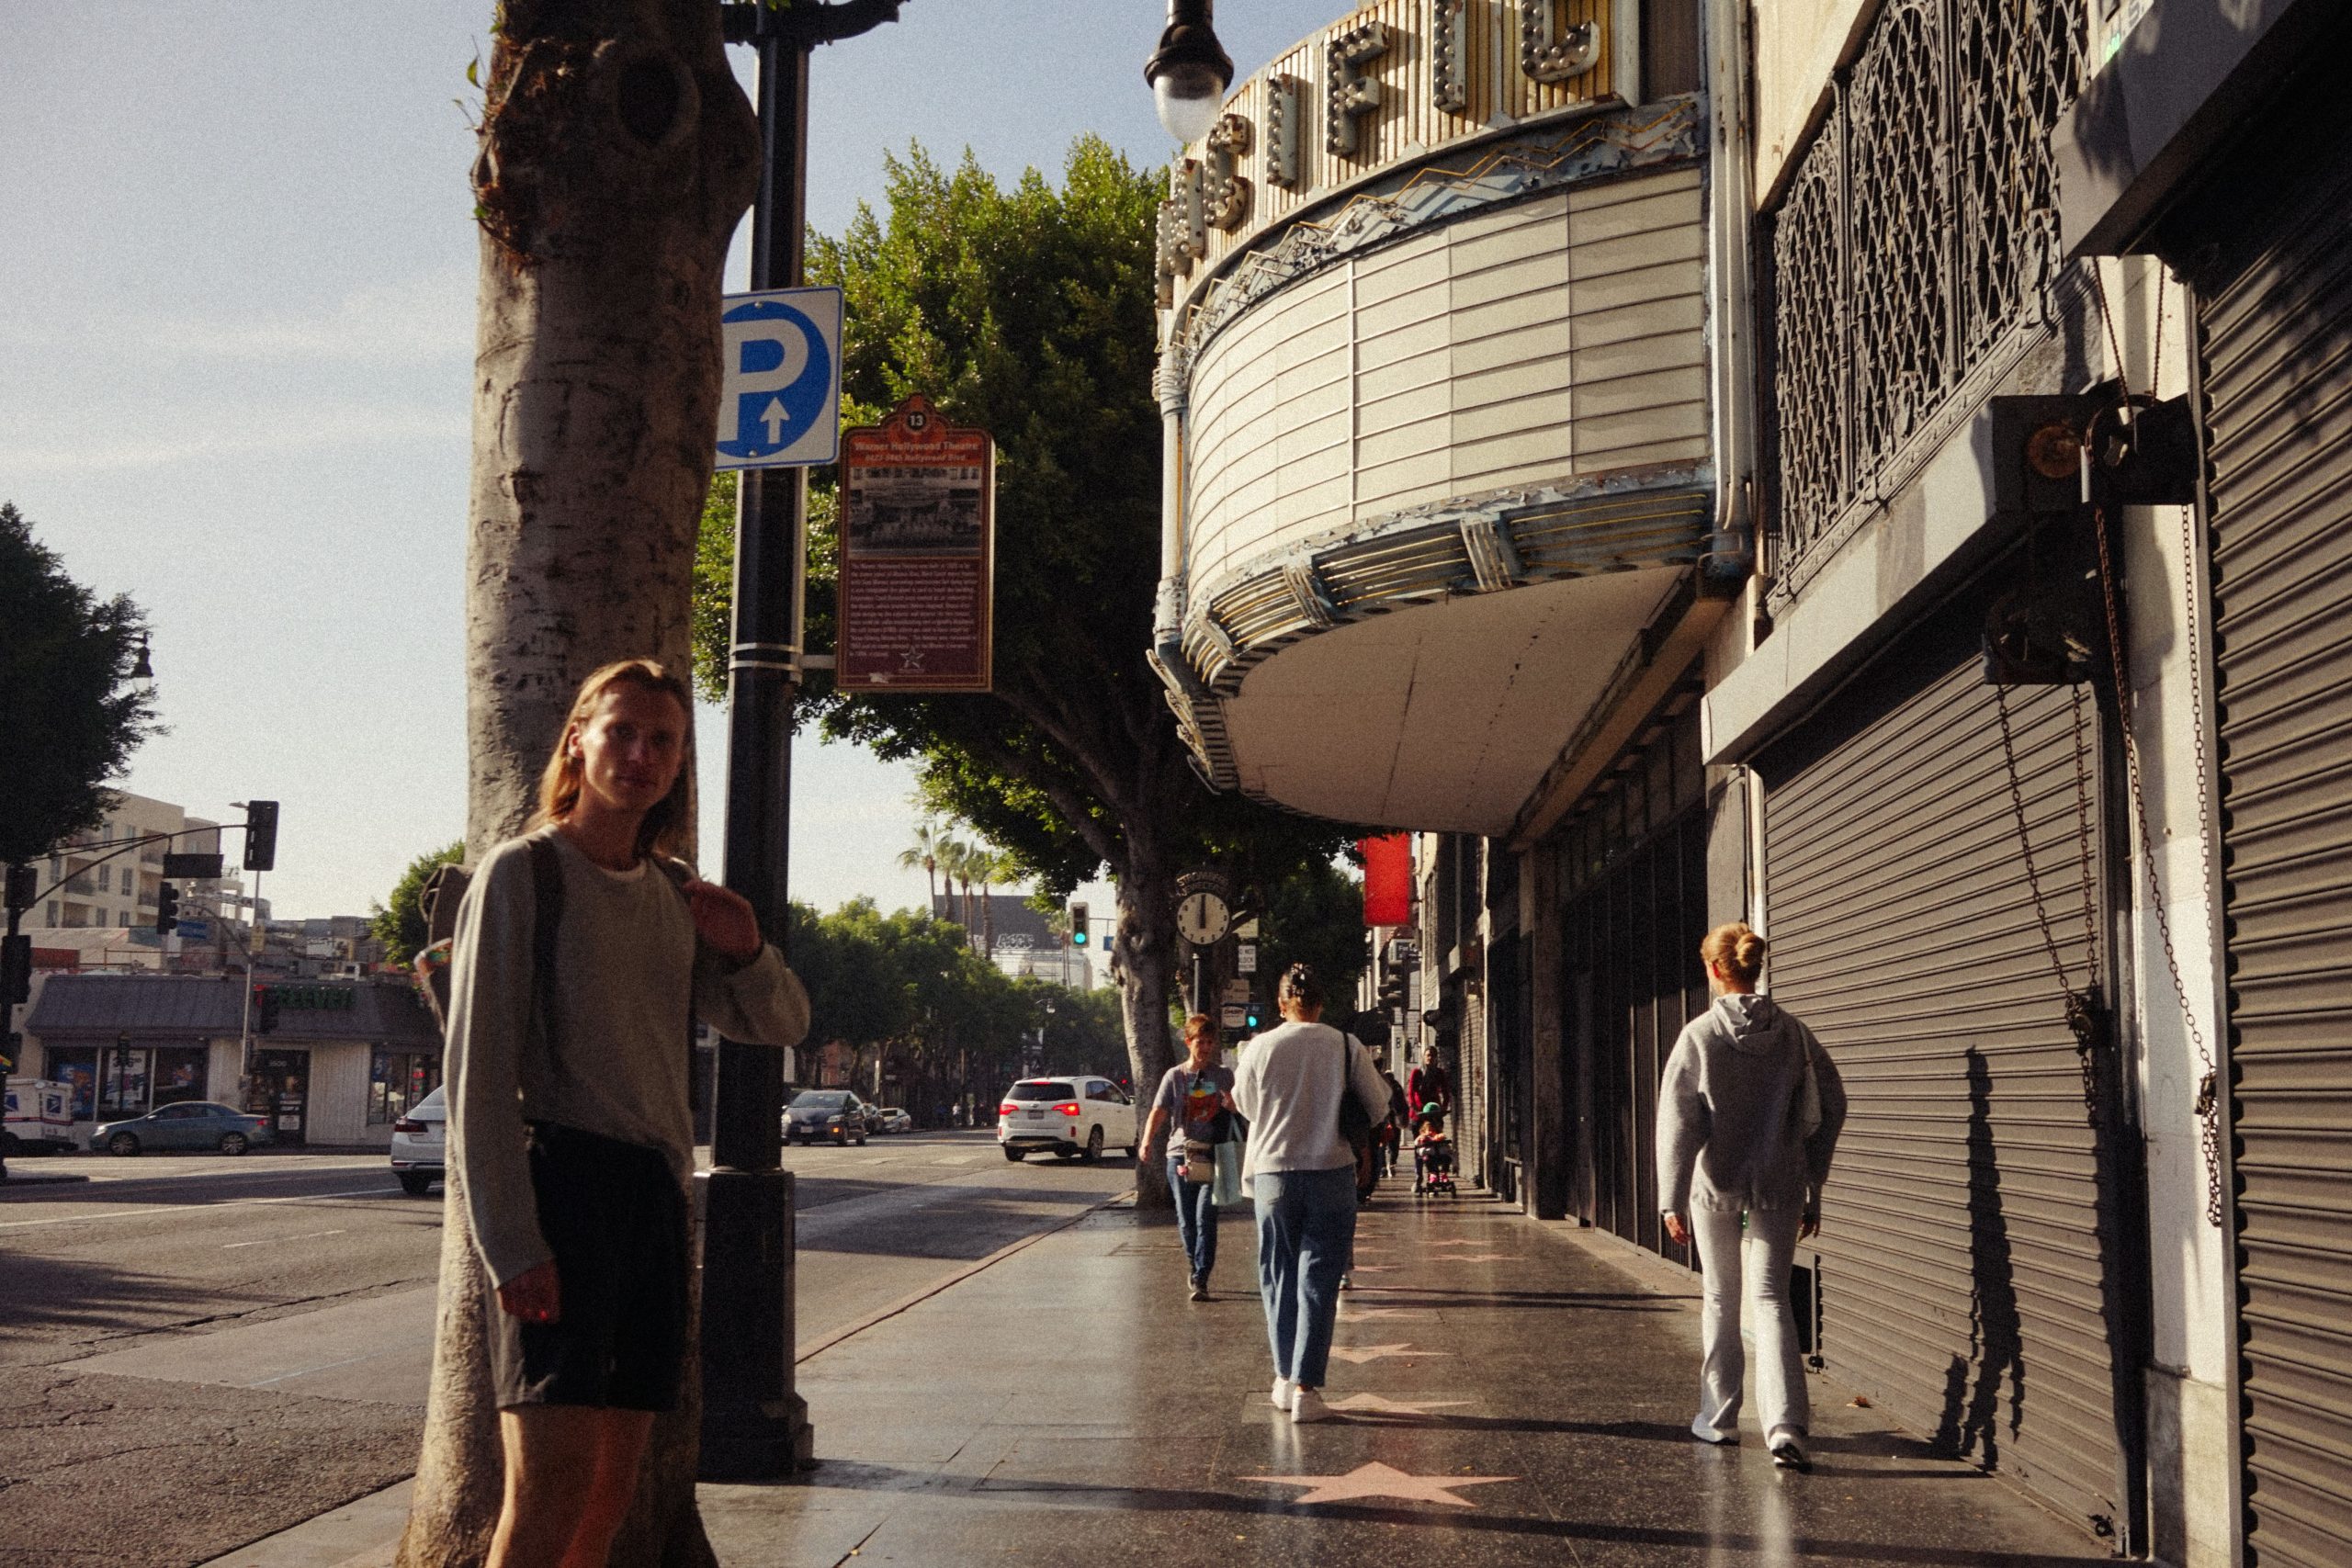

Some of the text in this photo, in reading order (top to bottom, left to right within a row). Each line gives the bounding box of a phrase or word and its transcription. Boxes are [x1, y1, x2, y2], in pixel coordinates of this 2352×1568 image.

[1155, 0, 1600, 310] CIFIC
[717, 319, 808, 442] P
[854, 441, 978, 452] Warner Hollywood Theatre
[910, 415, 924, 426] 13
